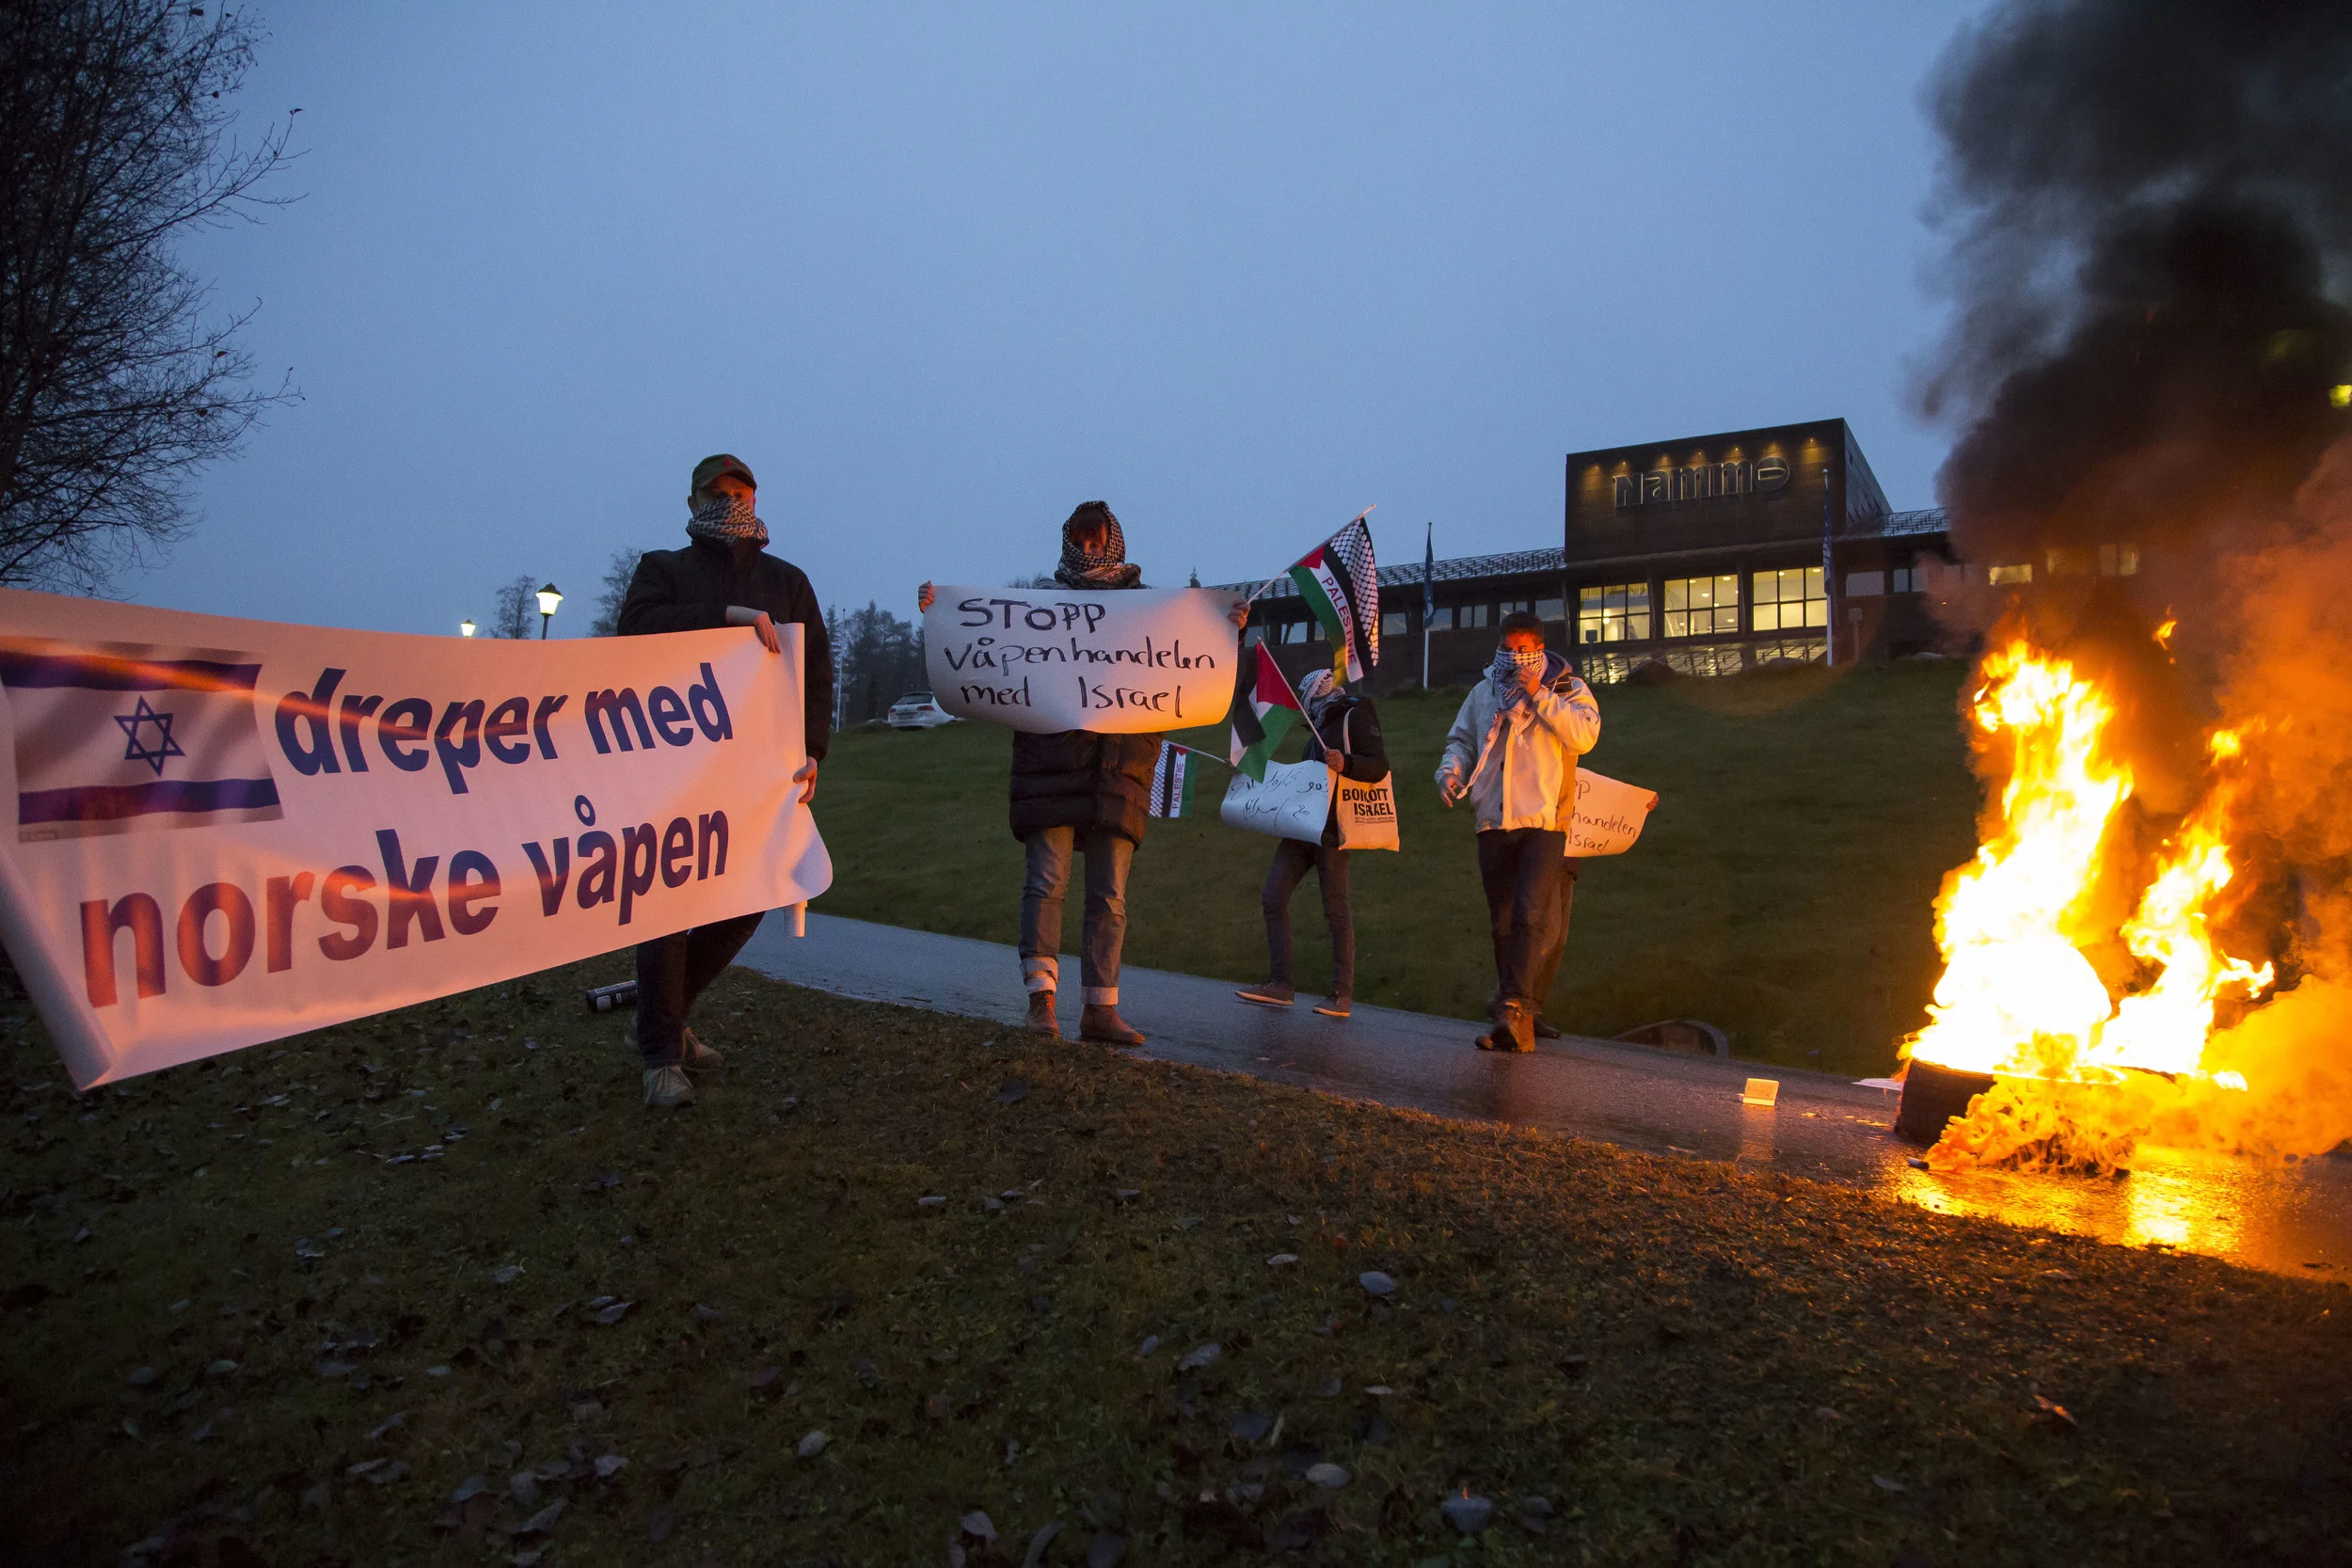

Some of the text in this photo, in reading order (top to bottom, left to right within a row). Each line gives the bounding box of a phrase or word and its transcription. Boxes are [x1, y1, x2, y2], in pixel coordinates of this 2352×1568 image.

[958, 597, 1106, 633] STOPP
[1323, 577, 1357, 664] PALESTINE
[960, 676, 1183, 718] med Israel
[275, 662, 734, 795] dreper med
[1172, 763, 1184, 809] PALESTINE
[1342, 787, 1389, 802] BOIKOTT
[1354, 802, 1394, 816] ISRAEL
[81, 795, 730, 1007] norske våpen
